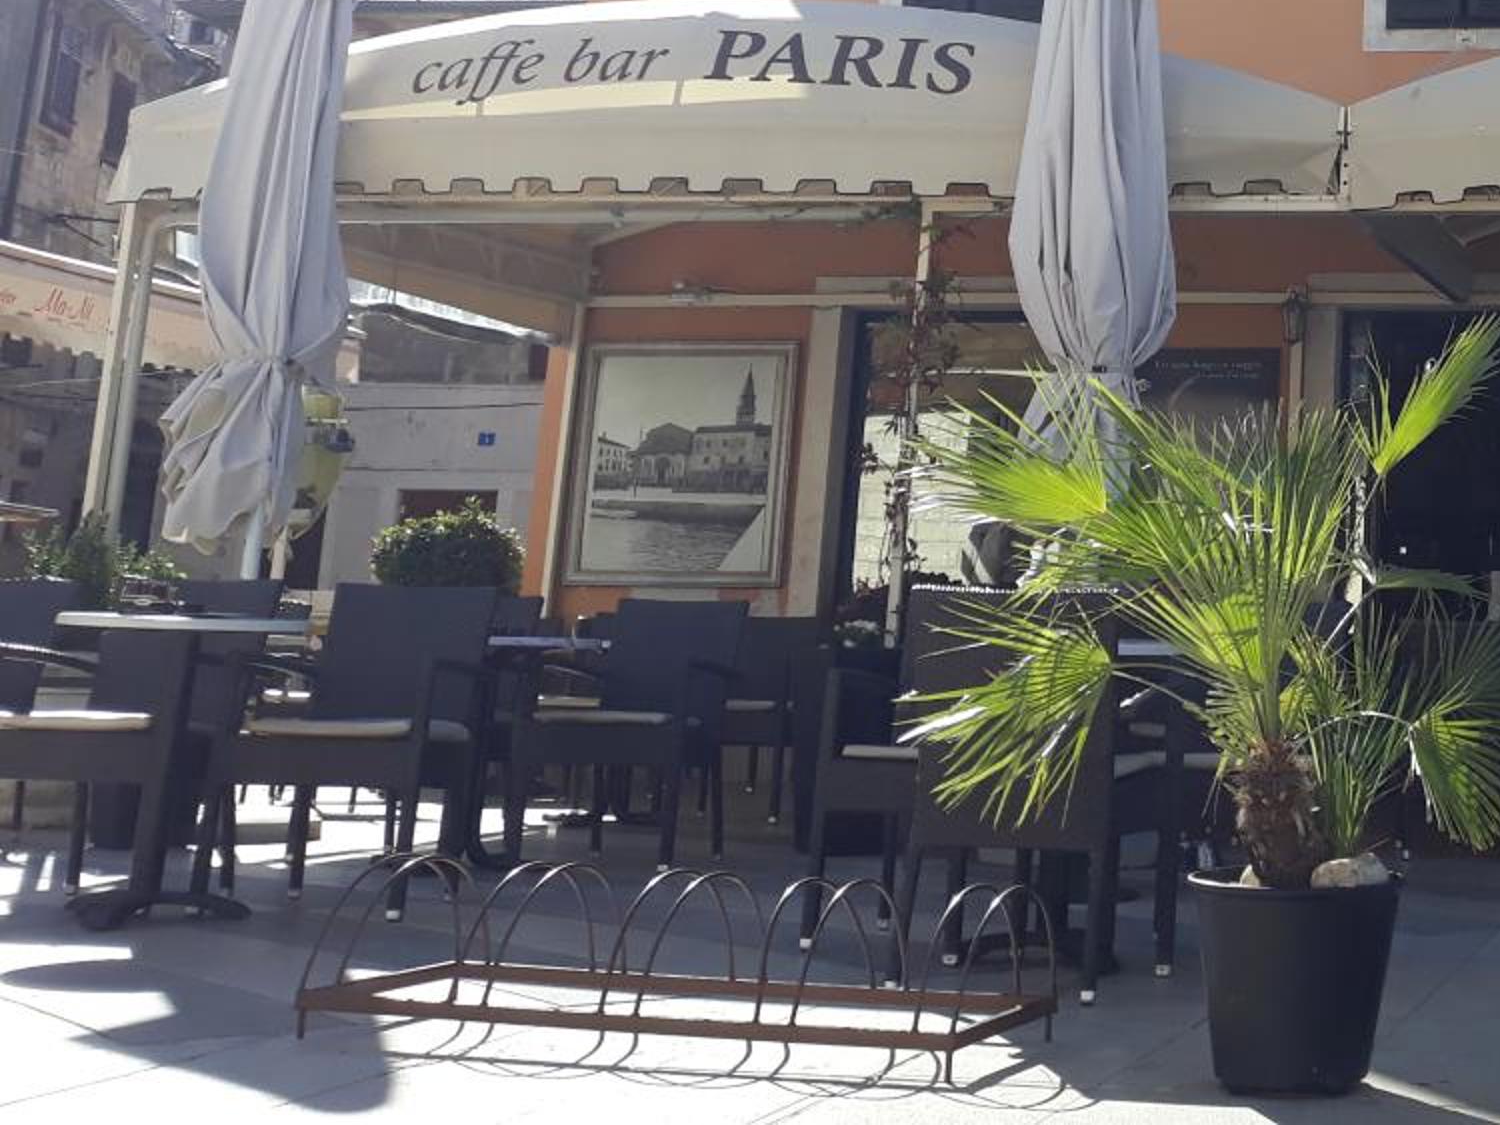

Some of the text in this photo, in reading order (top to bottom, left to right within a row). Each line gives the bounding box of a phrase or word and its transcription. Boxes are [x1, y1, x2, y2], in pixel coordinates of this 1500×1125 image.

[412, 29, 976, 106] caffe bar PARIS
